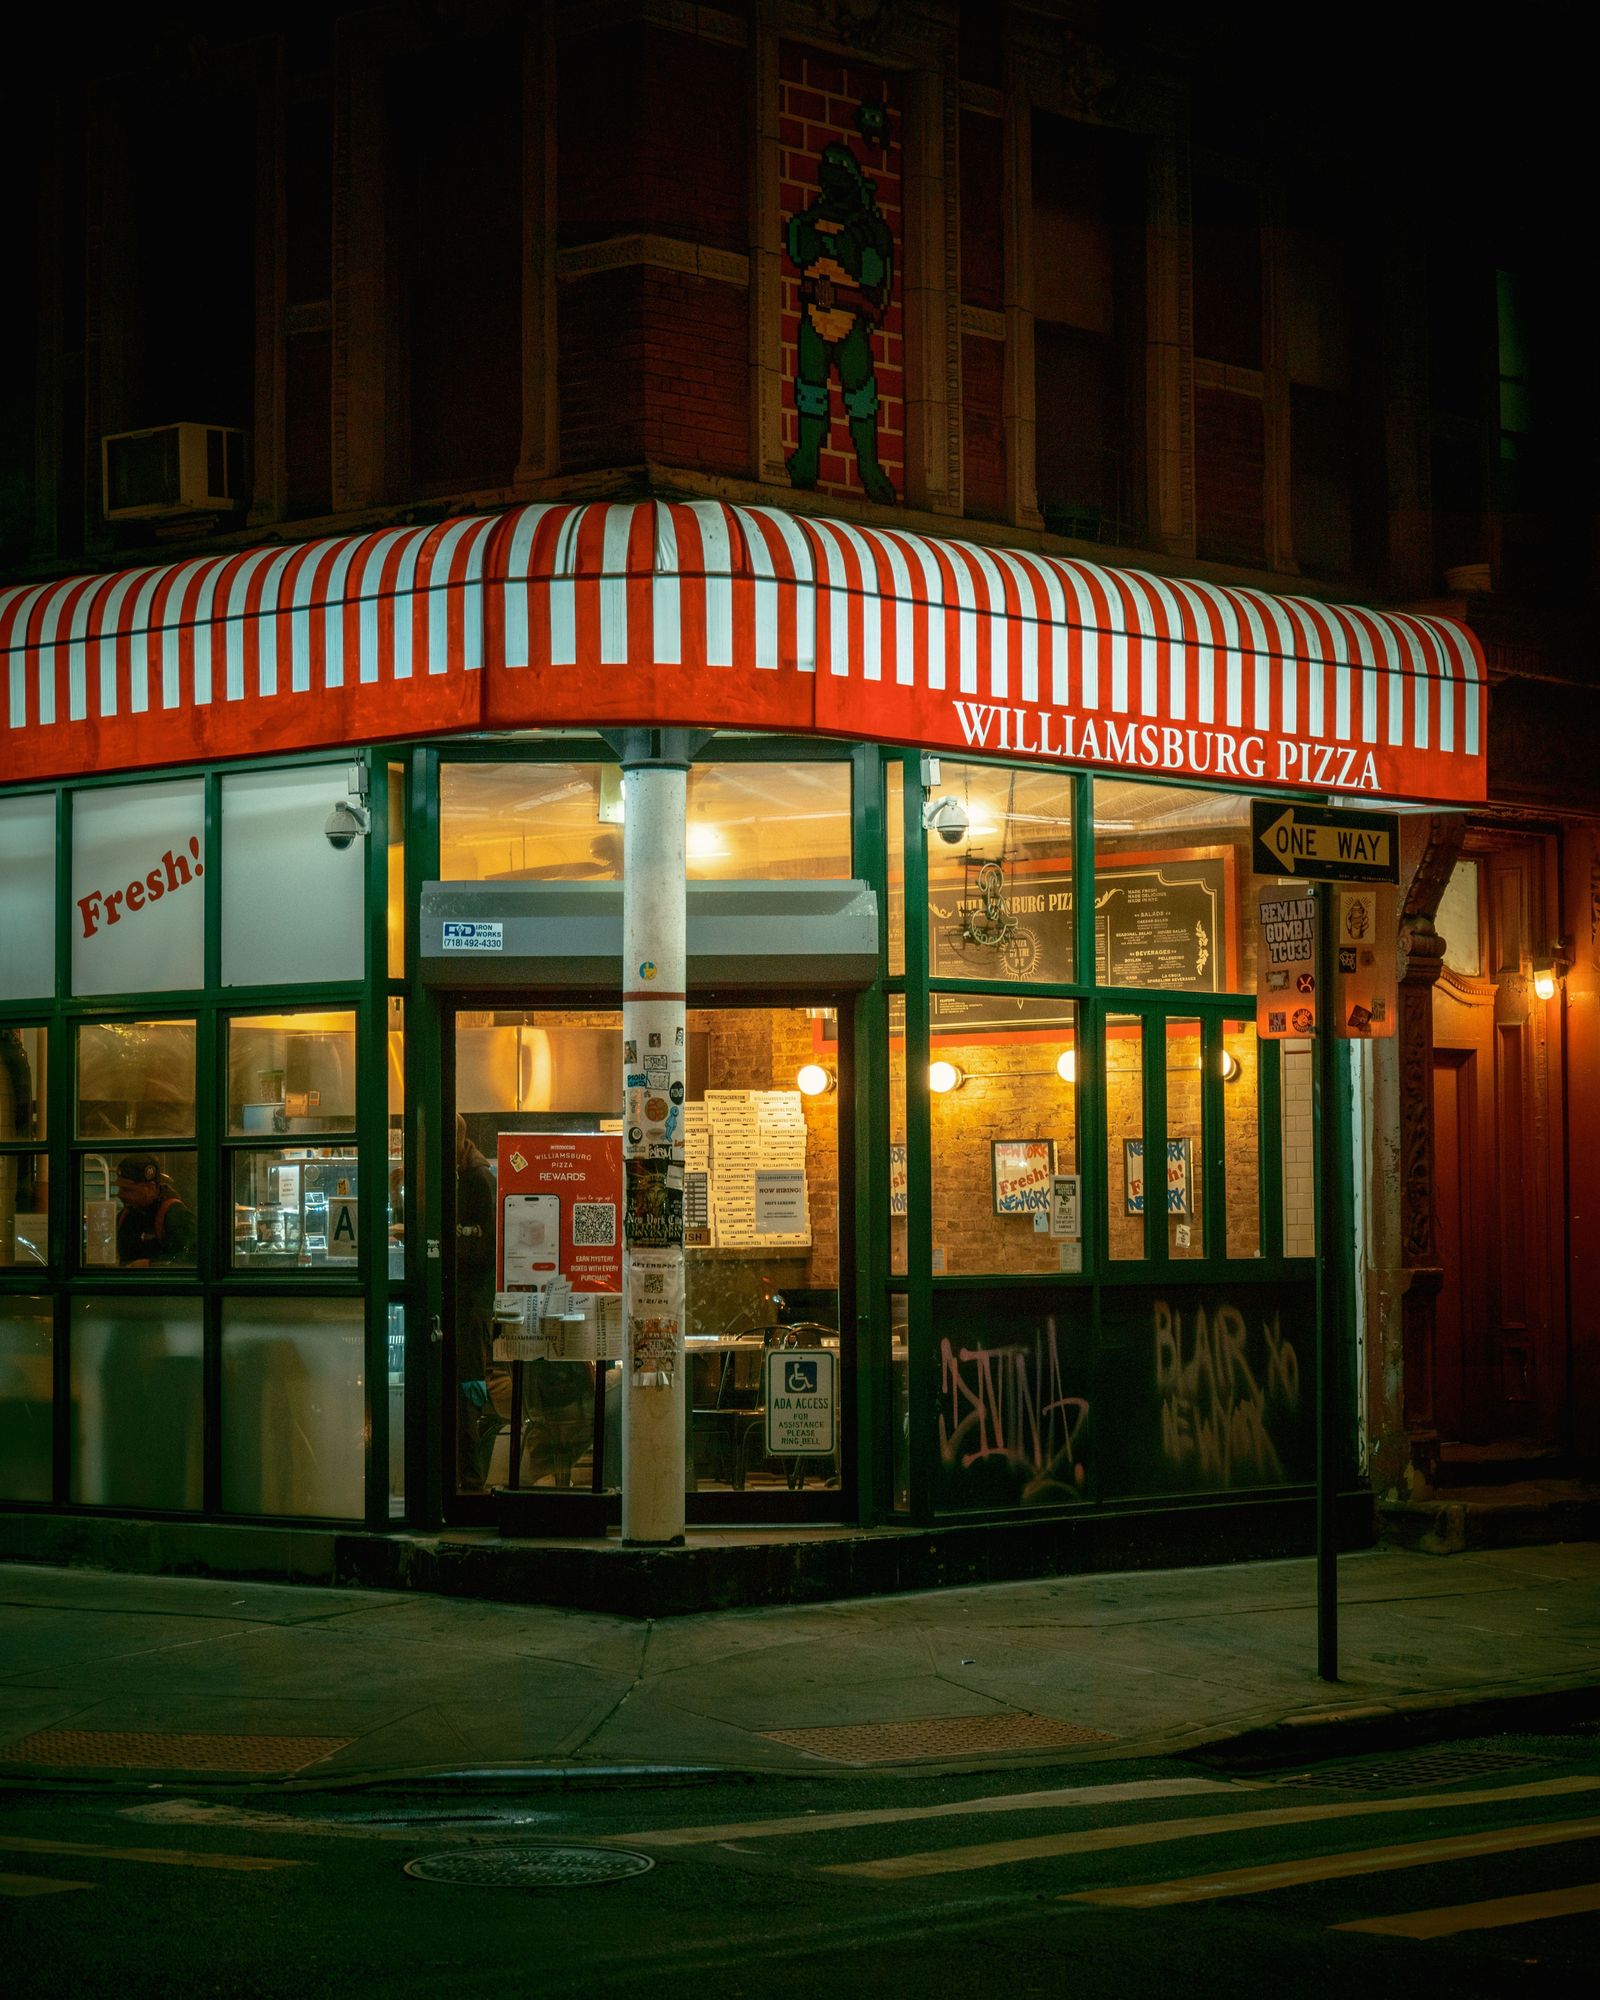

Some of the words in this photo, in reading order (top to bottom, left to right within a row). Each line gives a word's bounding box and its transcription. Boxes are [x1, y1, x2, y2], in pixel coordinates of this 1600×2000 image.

[953, 701, 1265, 777] WILLIAMSBURG
[1277, 740, 1382, 790] PIZZA
[1276, 826, 1317, 856] ONE
[1338, 832, 1381, 861] WAY
[77, 836, 204, 939] Fresh!
[1260, 899, 1315, 924] REMAND
[444, 939, 463, 947] (718)
[464, 940, 502, 948] 492-4330
[1270, 940, 1311, 962] TCU33
[534, 1152, 592, 1161] WILLIAMSBURG
[539, 1172, 586, 1181] REWARDS
[999, 1164, 1049, 1196] Fresh!
[333, 1206, 355, 1240] A
[774, 1398, 792, 1409] ADA
[796, 1398, 829, 1409] ACCESS
